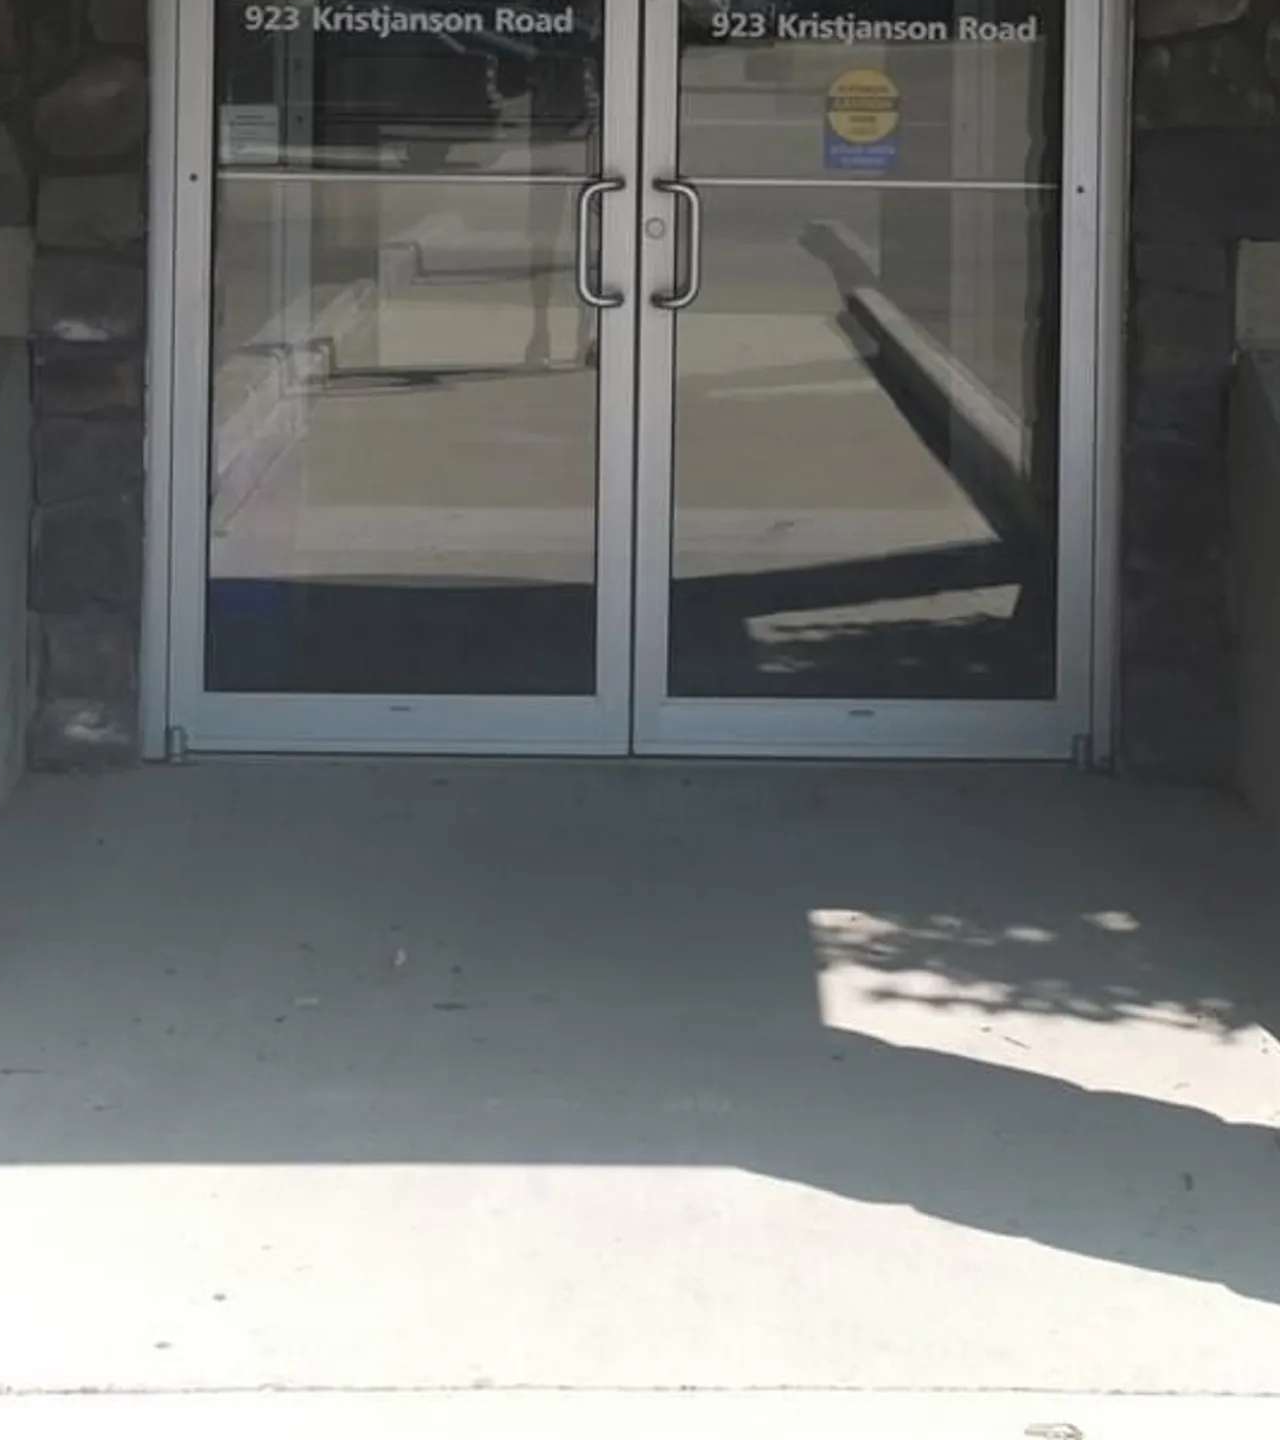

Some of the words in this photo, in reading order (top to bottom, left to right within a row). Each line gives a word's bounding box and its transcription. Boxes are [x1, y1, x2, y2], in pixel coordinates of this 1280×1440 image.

[243, 5, 300, 31] 923
[313, 4, 484, 38] Kristjanson
[495, 6, 574, 33] Road
[711, 13, 767, 38] 923
[778, 12, 948, 45] Kristjanson
[958, 15, 1037, 42] Road
